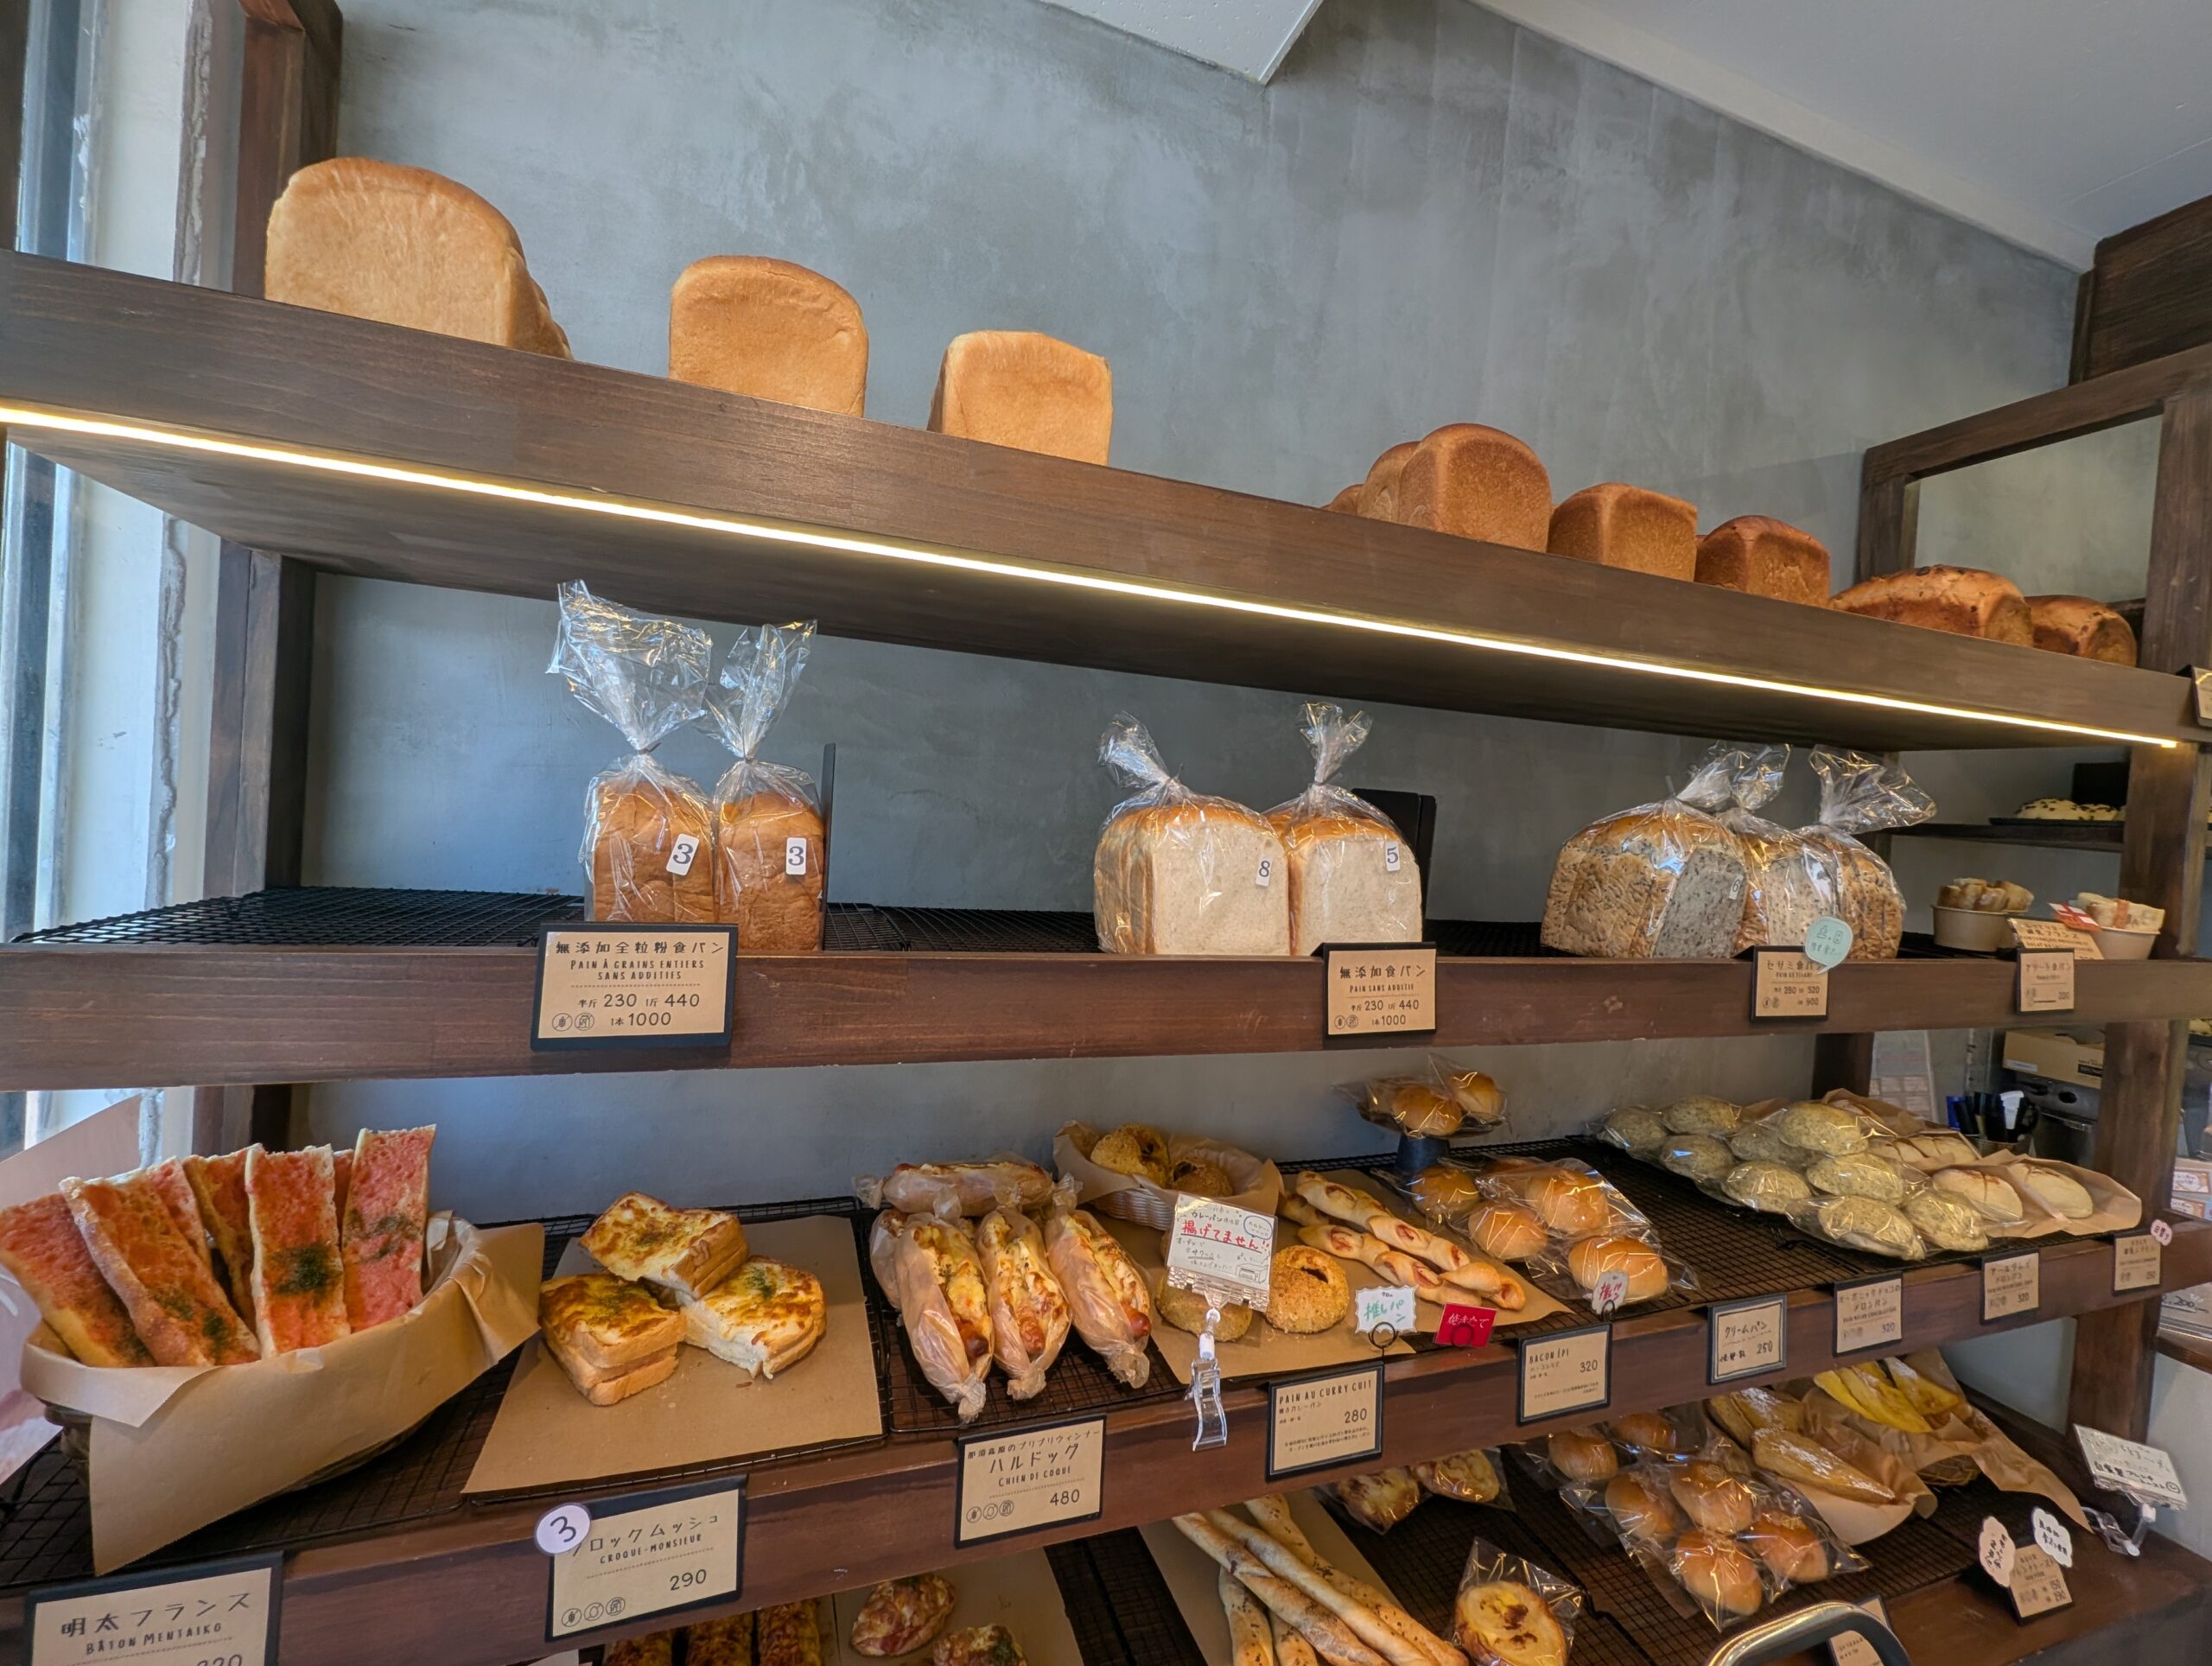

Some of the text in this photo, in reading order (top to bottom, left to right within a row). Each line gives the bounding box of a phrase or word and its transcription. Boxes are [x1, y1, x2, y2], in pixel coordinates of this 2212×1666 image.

[673, 843, 693, 864] 3
[789, 846, 804, 866] 3
[1386, 847, 1399, 864] 5
[1258, 860, 1271, 878] 8
[570, 960, 597, 970] PAIN
[614, 960, 655, 969] GRAINS
[660, 959, 705, 969] ENTIERS
[598, 971, 682, 980] SANS ADDITIFS
[604, 994, 638, 1008] 230
[664, 994, 700, 1008] 440
[1365, 1000, 1384, 1011] 230
[1399, 1000, 1420, 1010] 440
[628, 1012, 671, 1026] 1000
[1381, 1014, 1407, 1026] 1000
[1756, 1340, 1773, 1355] 250
[1580, 1358, 1599, 1373] 320
[1279, 1393, 1300, 1405] PAIN
[1305, 1389, 1316, 1401] AU
[1319, 1384, 1348, 1397] CURRY
[1344, 1408, 1368, 1424] 280
[989, 1442, 1079, 1473] ハルドッグ
[998, 1472, 1027, 1487] CHIEN
[1030, 1472, 1039, 1481] DE
[1050, 1489, 1080, 1506] 480
[550, 1515, 577, 1542] 3
[600, 1533, 702, 1564] CROQUE-MONSIEUR
[670, 1568, 708, 1591] 290
[60, 1593, 250, 1637] 明太フランス
[143, 1622, 223, 1647] MENTAIKO
